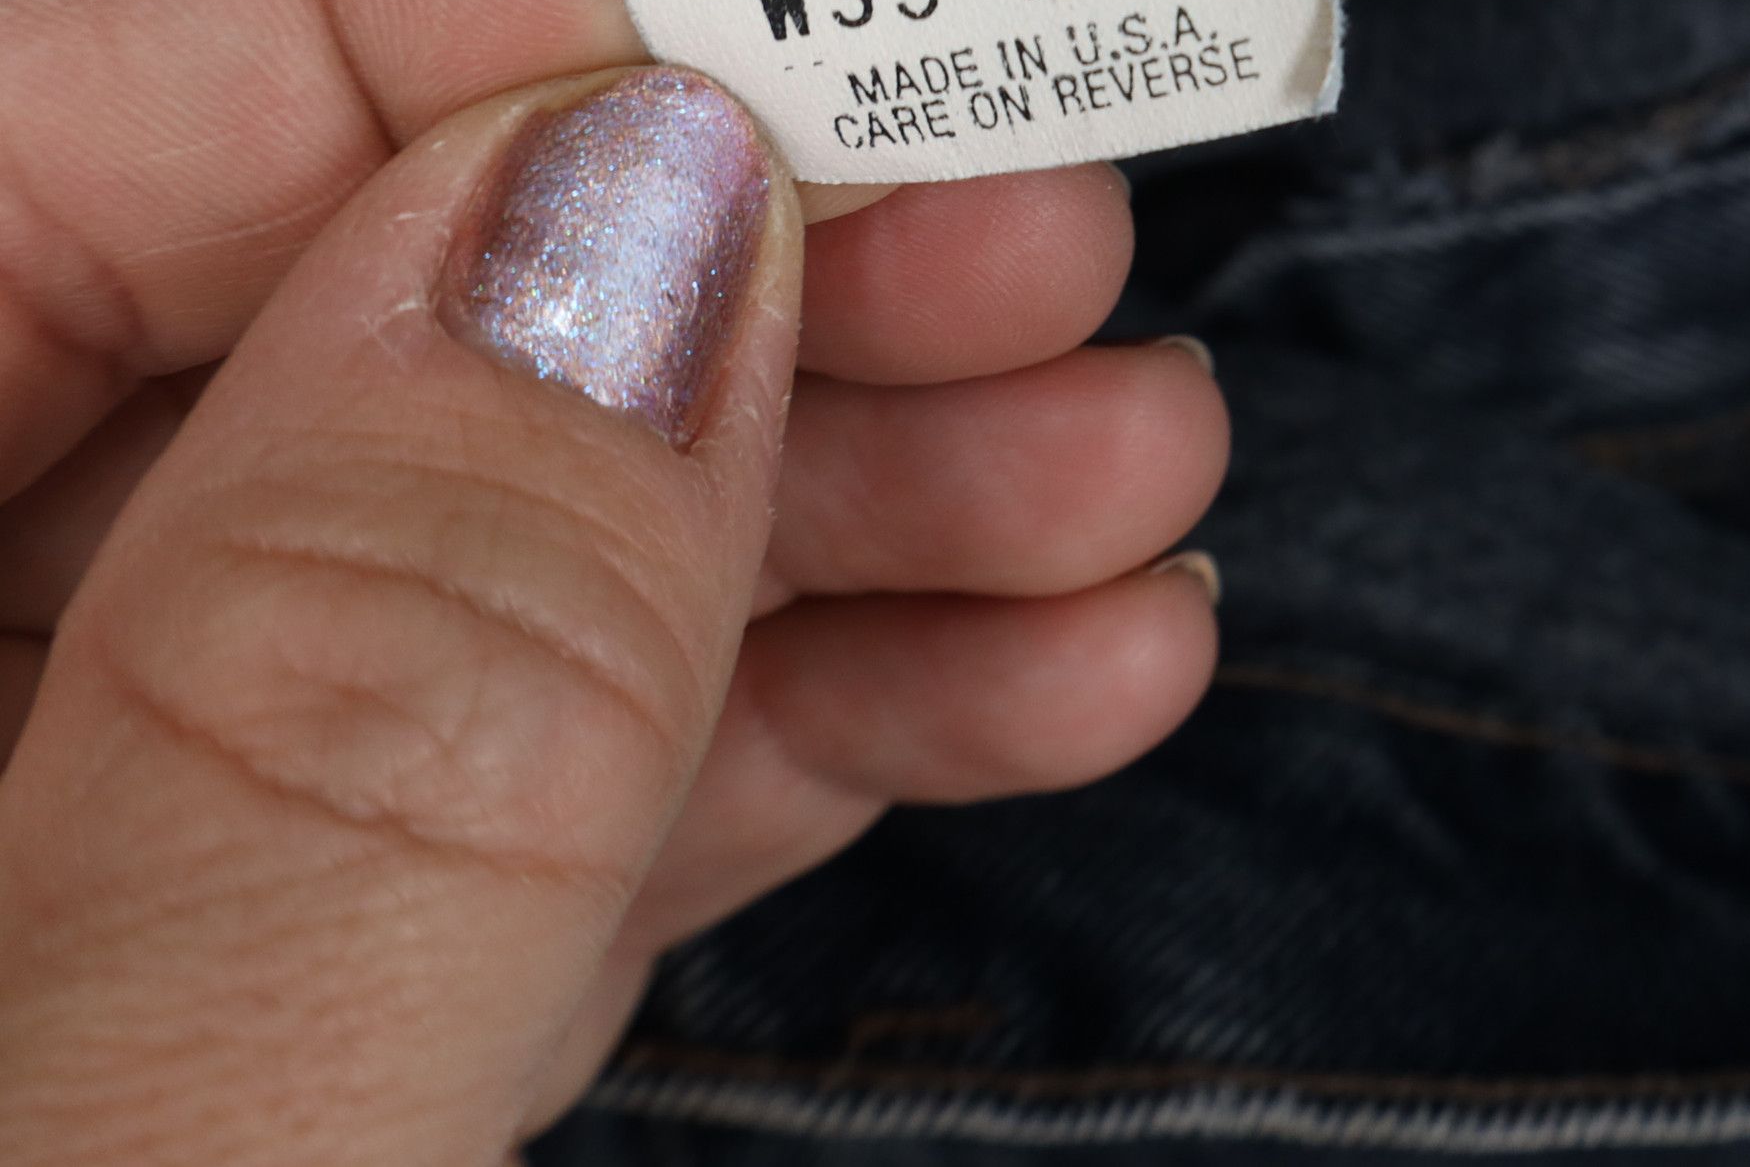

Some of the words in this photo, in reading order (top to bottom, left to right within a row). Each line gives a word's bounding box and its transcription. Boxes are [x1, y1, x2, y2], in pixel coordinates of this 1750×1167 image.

[833, 99, 957, 151] CARE
[968, 84, 1032, 134] ON
[1052, 38, 1261, 118] REVERSE
[847, 48, 984, 107] MADE
[996, 35, 1049, 81] IN
[1066, 6, 1218, 67] U.S.A.
